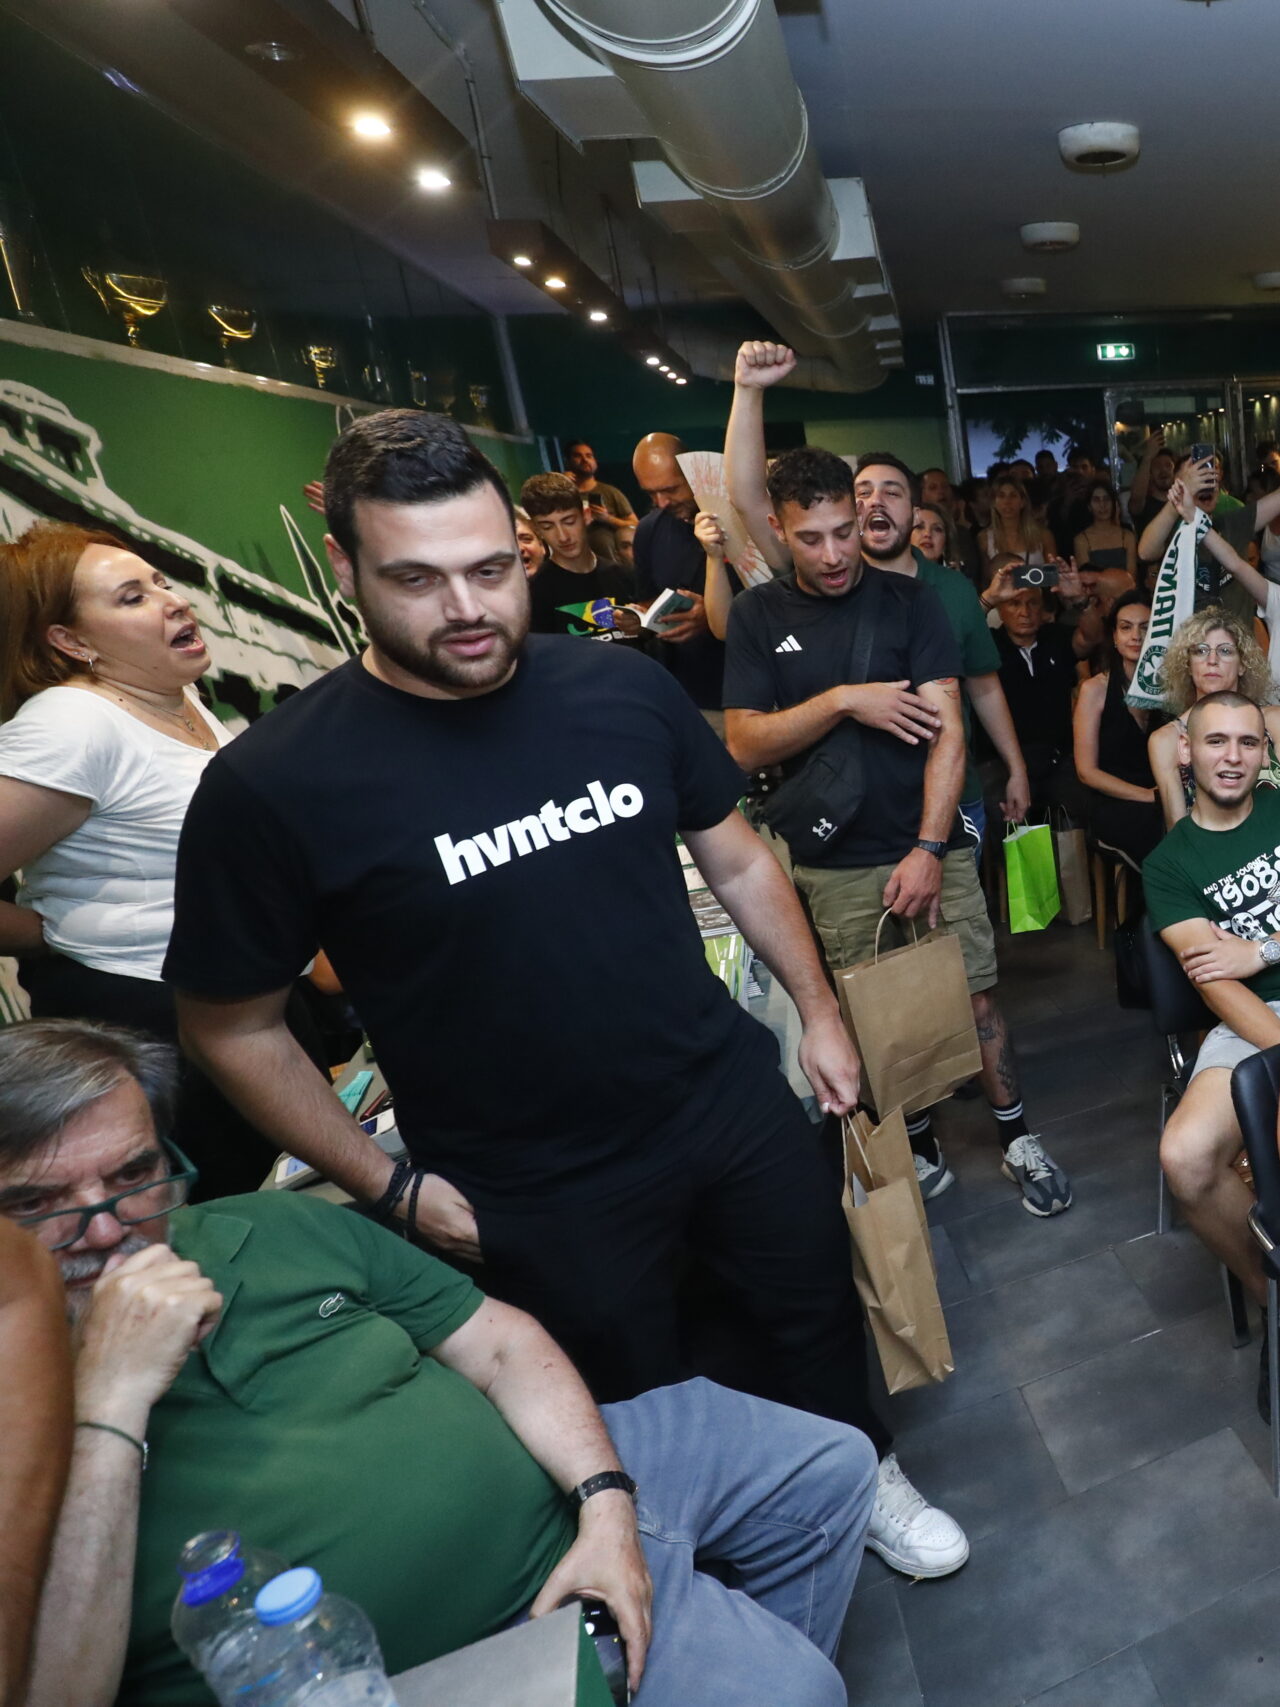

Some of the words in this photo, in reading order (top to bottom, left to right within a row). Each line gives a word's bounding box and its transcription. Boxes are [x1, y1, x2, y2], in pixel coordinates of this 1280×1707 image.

[434, 780, 644, 885] hvntclo
[1203, 883, 1219, 896] AND
[1217, 873, 1235, 887] THE
[1213, 859, 1278, 912] 1908
